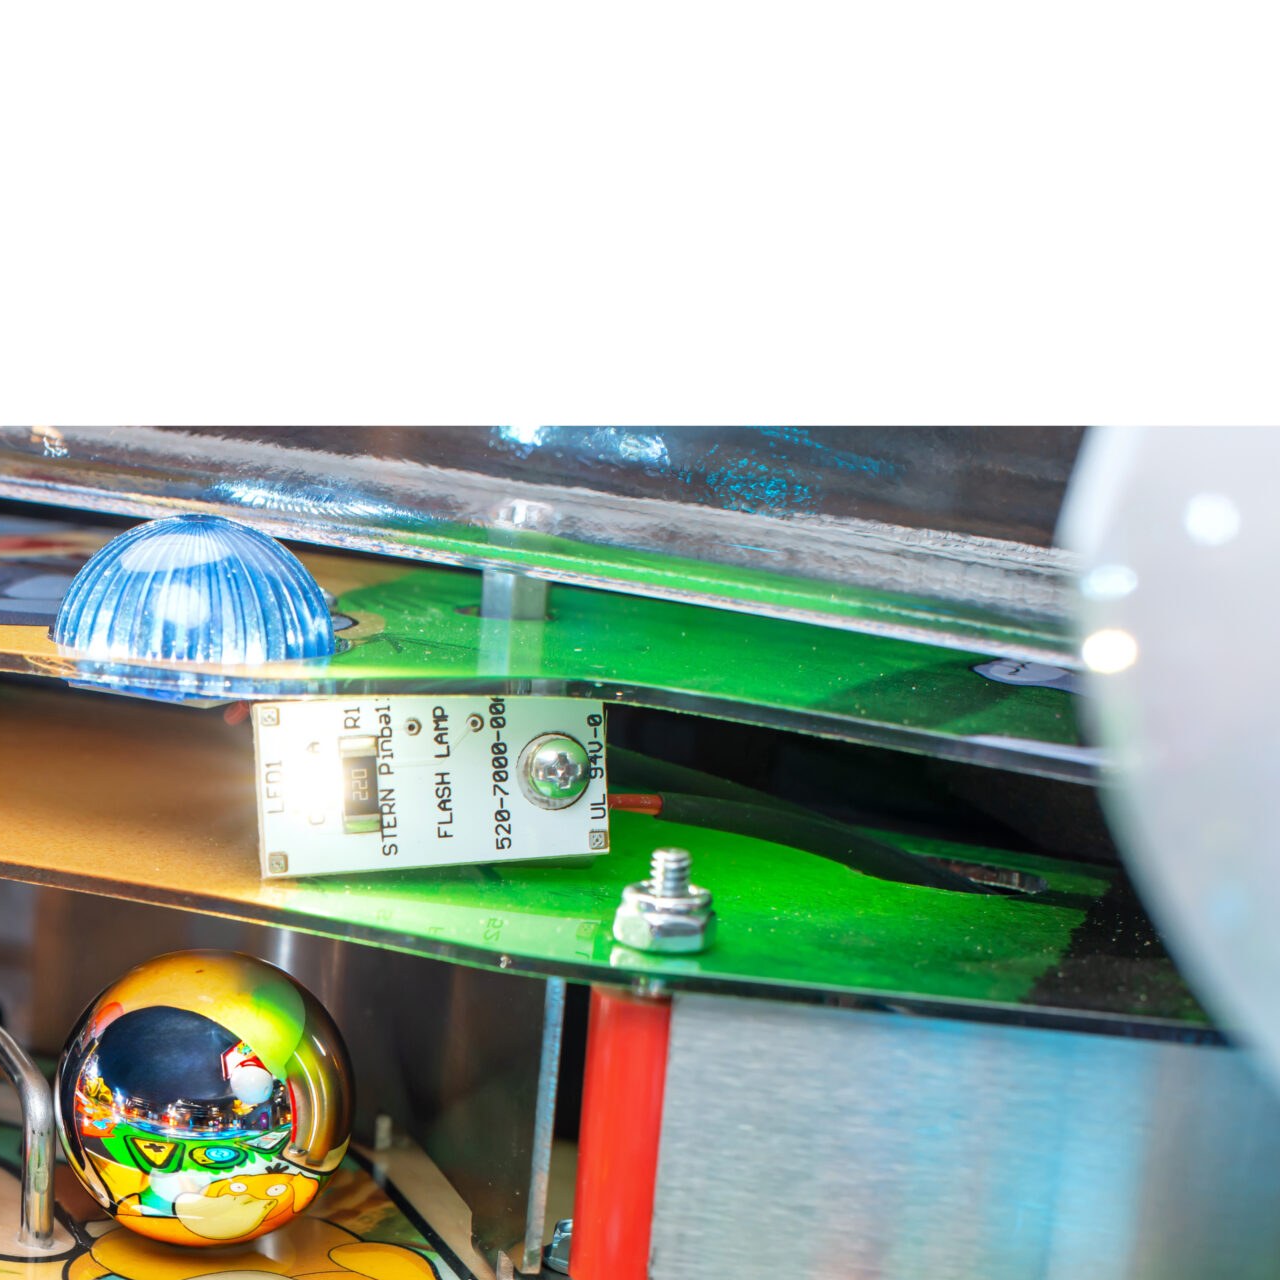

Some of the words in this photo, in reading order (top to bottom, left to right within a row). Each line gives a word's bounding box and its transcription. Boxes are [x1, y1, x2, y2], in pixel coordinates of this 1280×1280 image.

[344, 706, 361, 729] R1
[375, 698, 394, 775] Pinbal
[432, 705, 450, 758] LAMP
[587, 713, 604, 779] 94V-0
[352, 768, 368, 800] 220
[434, 771, 453, 838] FLASH
[590, 793, 606, 819] UL
[379, 788, 398, 856] STERN
